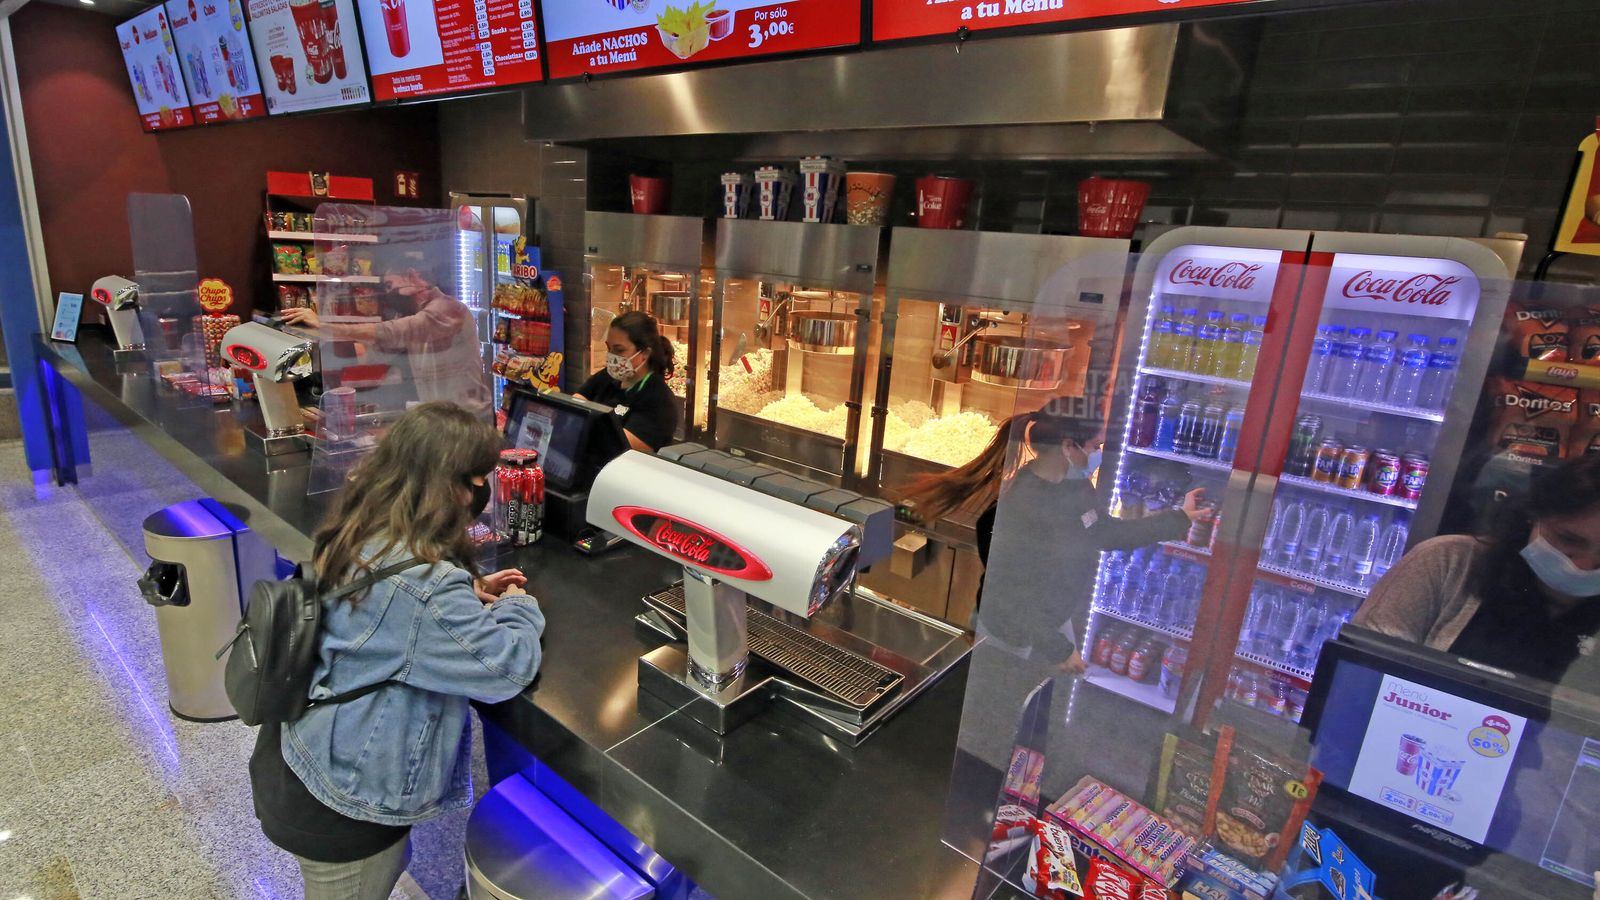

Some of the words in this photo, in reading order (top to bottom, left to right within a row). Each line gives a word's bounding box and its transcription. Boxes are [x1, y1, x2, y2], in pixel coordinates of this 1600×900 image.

[754, 10, 768, 21] Por
[769, 7, 788, 20] sólo
[961, 6, 972, 20] a
[976, 2, 1000, 18] tu
[571, 41, 602, 56] Añade
[602, 32, 648, 51] NACHOS
[748, 21, 795, 48] 3,00€
[590, 58, 597, 67] a
[597, 54, 609, 66] tu
[609, 49, 637, 64] Menú
[923, 201, 942, 210] Coke
[1168, 257, 1265, 291] Coca-Cola
[200, 286, 227, 296] Chupa
[200, 294, 227, 306] Chups
[1342, 269, 1461, 307] Coca-Cola
[1505, 393, 1572, 412] Doritos
[1507, 453, 1543, 466] Doritos
[655, 520, 717, 562] Coca-Cola
[1383, 691, 1453, 721] Junior
[1471, 737, 1505, 755] 50%
[1104, 801, 1130, 824] mentos
[1050, 825, 1065, 855] bueno
[1134, 819, 1160, 846] mentos
[1142, 823, 1168, 849] mentos
[1207, 859, 1251, 883] HALLS
[1215, 852, 1260, 879] HALLS
